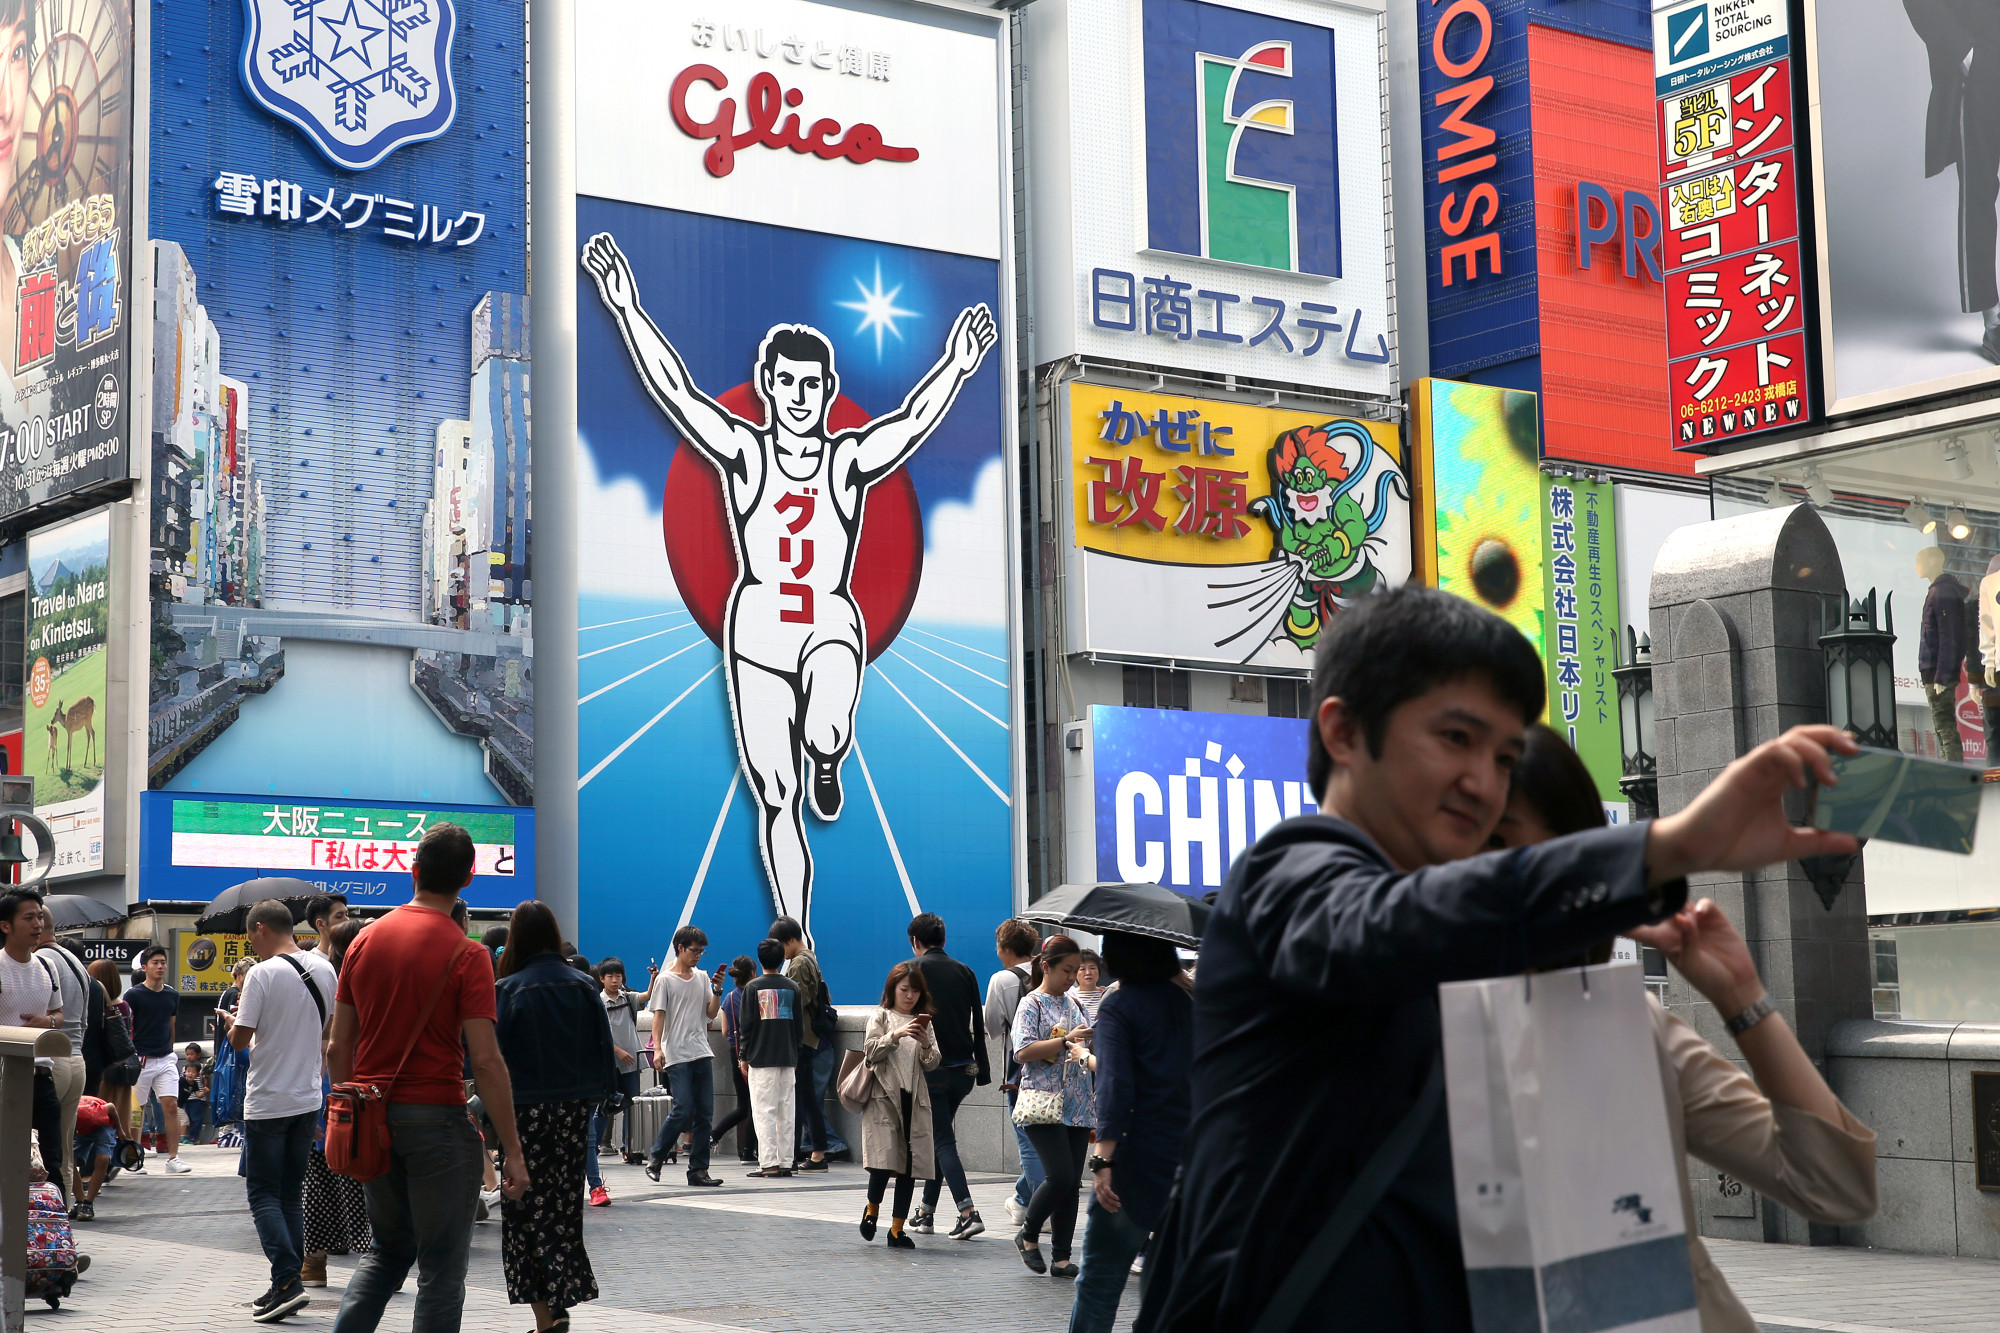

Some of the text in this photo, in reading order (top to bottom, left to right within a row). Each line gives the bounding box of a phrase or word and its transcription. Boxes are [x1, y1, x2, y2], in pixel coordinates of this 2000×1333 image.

[1715, 10, 1749, 29] TOTAL
[1715, 15, 1772, 42] SOURCING
[691, 16, 892, 82] おいしさと健康
[1670, 45, 1774, 87] 日研トータルソーシング株式会社
[669, 63, 920, 178] Glico
[1680, 89, 1718, 119] 当ビル
[1432, 0, 1501, 287] OMISE
[1674, 107, 1727, 156] 5F
[214, 171, 486, 247] 雪印メグミルク
[1672, 175, 1722, 207] 入口は
[1680, 197, 1715, 224] 右奥
[1733, 65, 1796, 387] インターネット
[1090, 267, 1391, 364] 日商エステム
[1680, 221, 1733, 401] コミック
[101, 409, 111, 425] SP
[1680, 388, 1761, 418] 06-6212-2423
[46, 404, 91, 447] START
[1098, 400, 1235, 457] かぜに
[1084, 455, 1252, 540] 改源
[773, 487, 819, 625] グリコ
[31, 581, 105, 619] Travel to Nara
[1585, 492, 1608, 724] 不動産再生のスペシャリスト
[30, 617, 94, 651] on Kintetsu.
[34, 673, 46, 693] 35
[262, 805, 427, 839] 大阪ニュース
[1115, 741, 1321, 887] CHIN
[84, 944, 128, 960] oilets
[200, 981, 234, 991] 株式会
